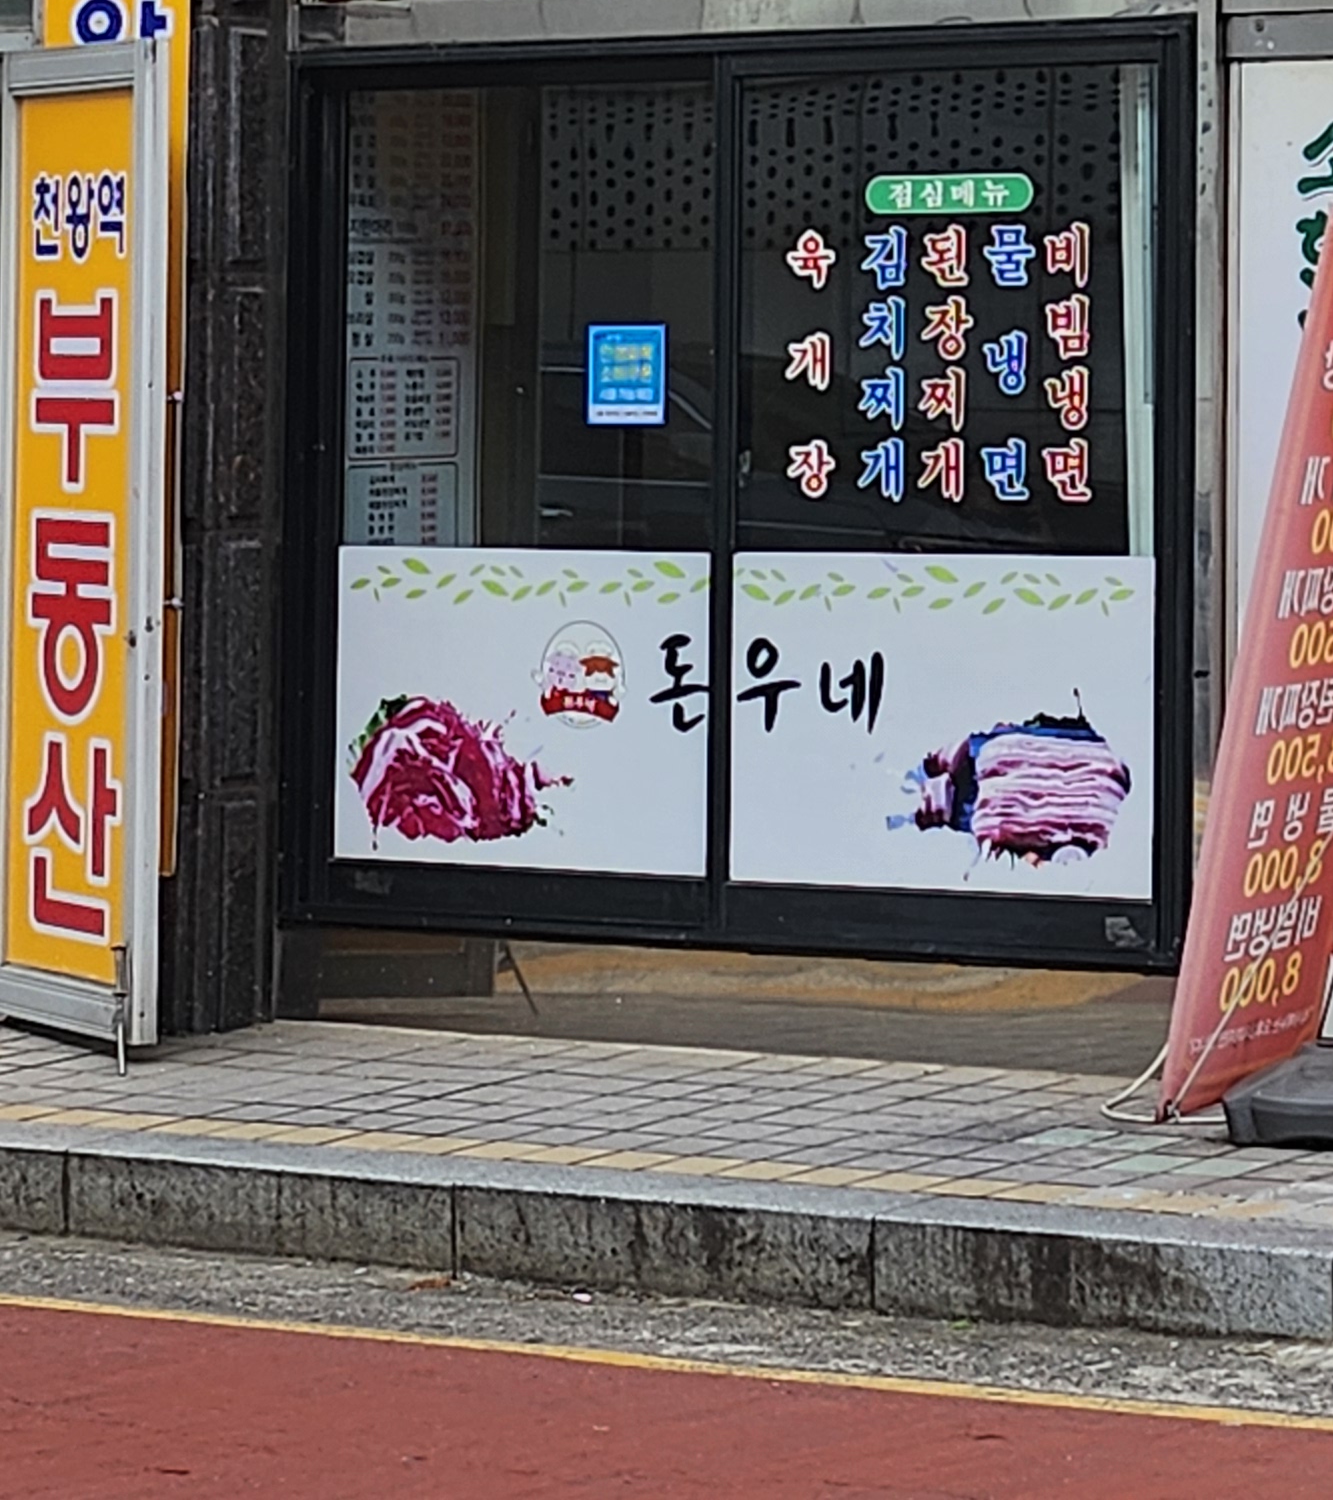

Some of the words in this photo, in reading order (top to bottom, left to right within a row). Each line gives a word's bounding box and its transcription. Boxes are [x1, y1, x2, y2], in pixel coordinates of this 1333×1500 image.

[32, 170, 128, 262] 천왕역
[888, 182, 1011, 209] 점심메뉴
[787, 229, 836, 499] 육개장
[859, 224, 908, 501] 김치찌개
[920, 224, 973, 501] 된장찌개
[982, 225, 1034, 499] 물냉면
[1043, 222, 1093, 501] 비빔냉면
[26, 290, 120, 942] 부동산
[650, 634, 885, 735] 돈우네
